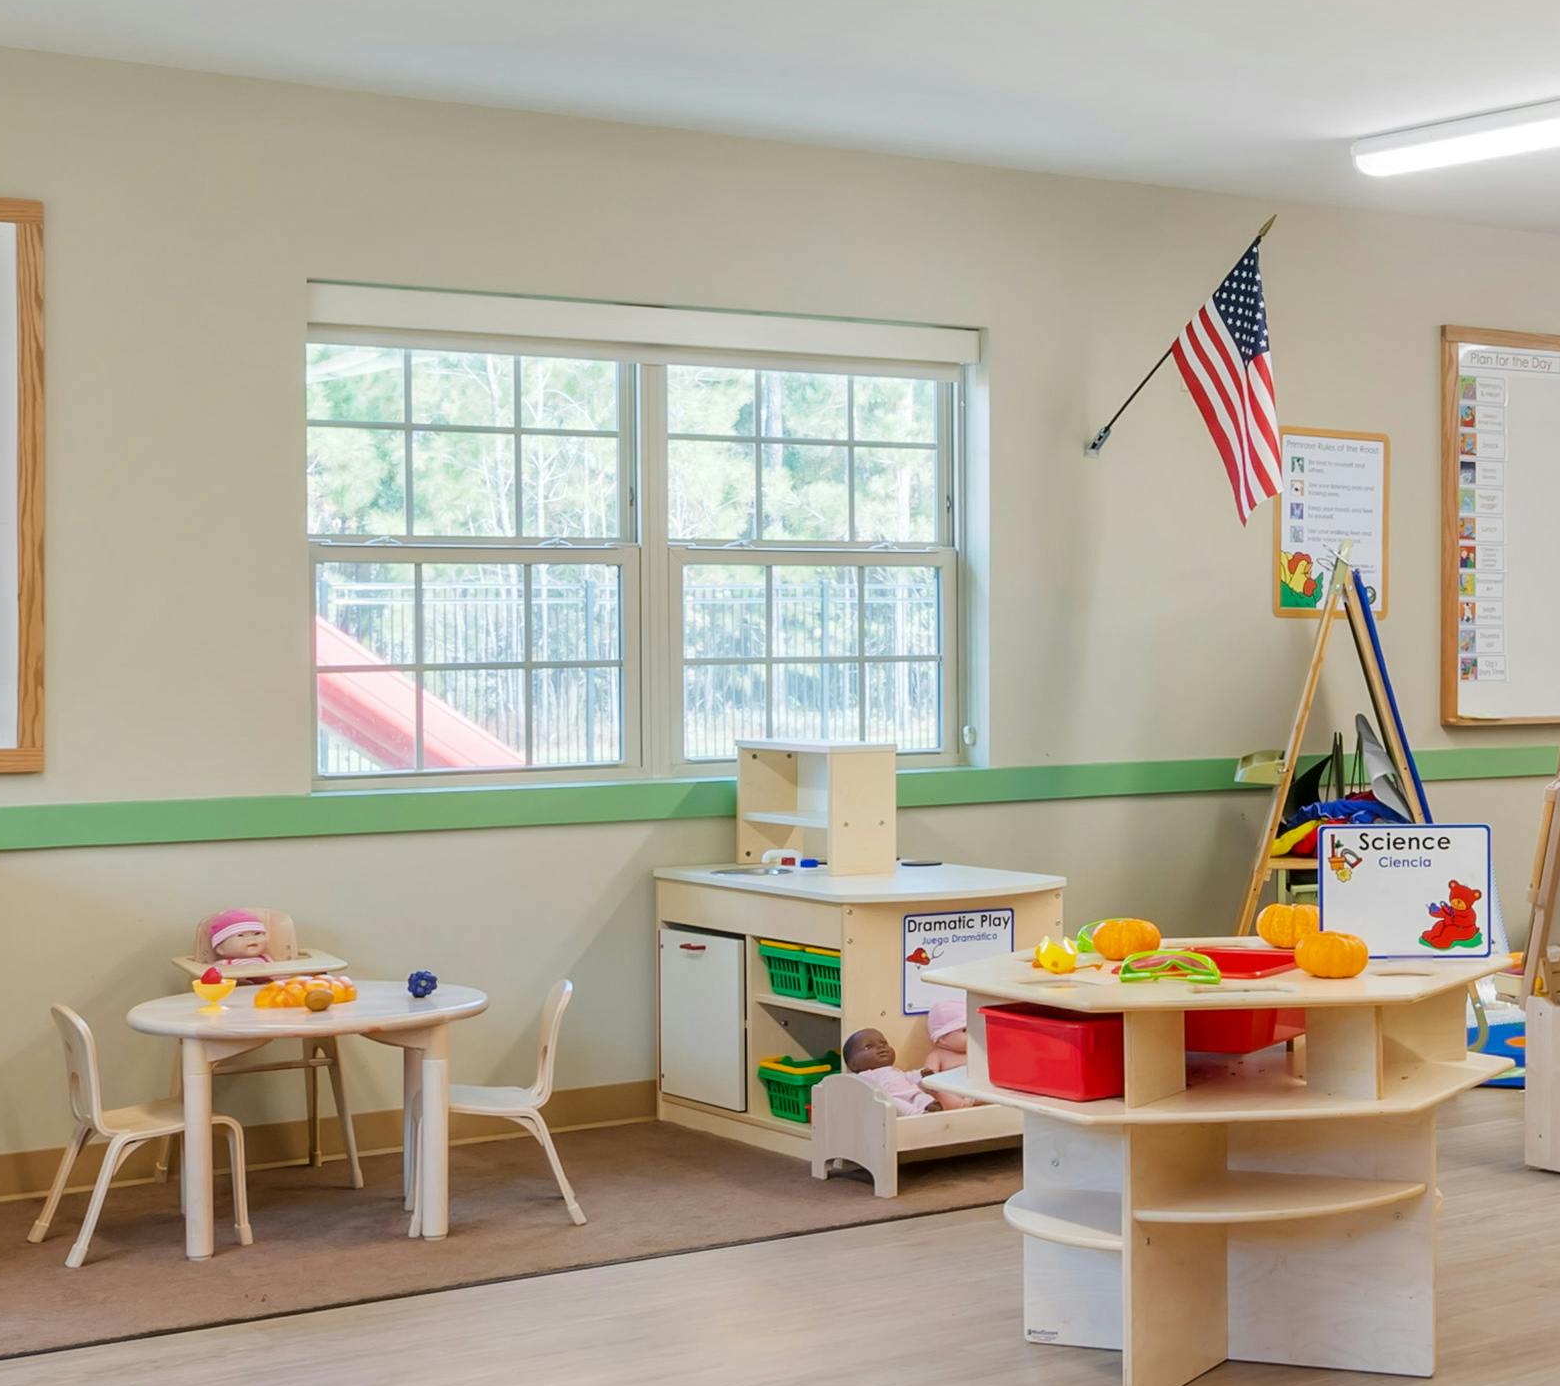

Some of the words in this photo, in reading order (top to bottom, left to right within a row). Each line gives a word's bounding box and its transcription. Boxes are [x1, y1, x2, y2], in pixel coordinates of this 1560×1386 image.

[1470, 352, 1493, 365] Plan
[1496, 355, 1509, 366] for
[1512, 356, 1529, 368] the
[1532, 357, 1553, 371] Day
[1358, 832, 1451, 851] Science
[1378, 856, 1432, 869] Ciencia
[907, 915, 976, 933] Dramatic
[980, 913, 1011, 930] Play
[921, 936, 950, 946] Juego
[951, 932, 998, 943] Dramático
